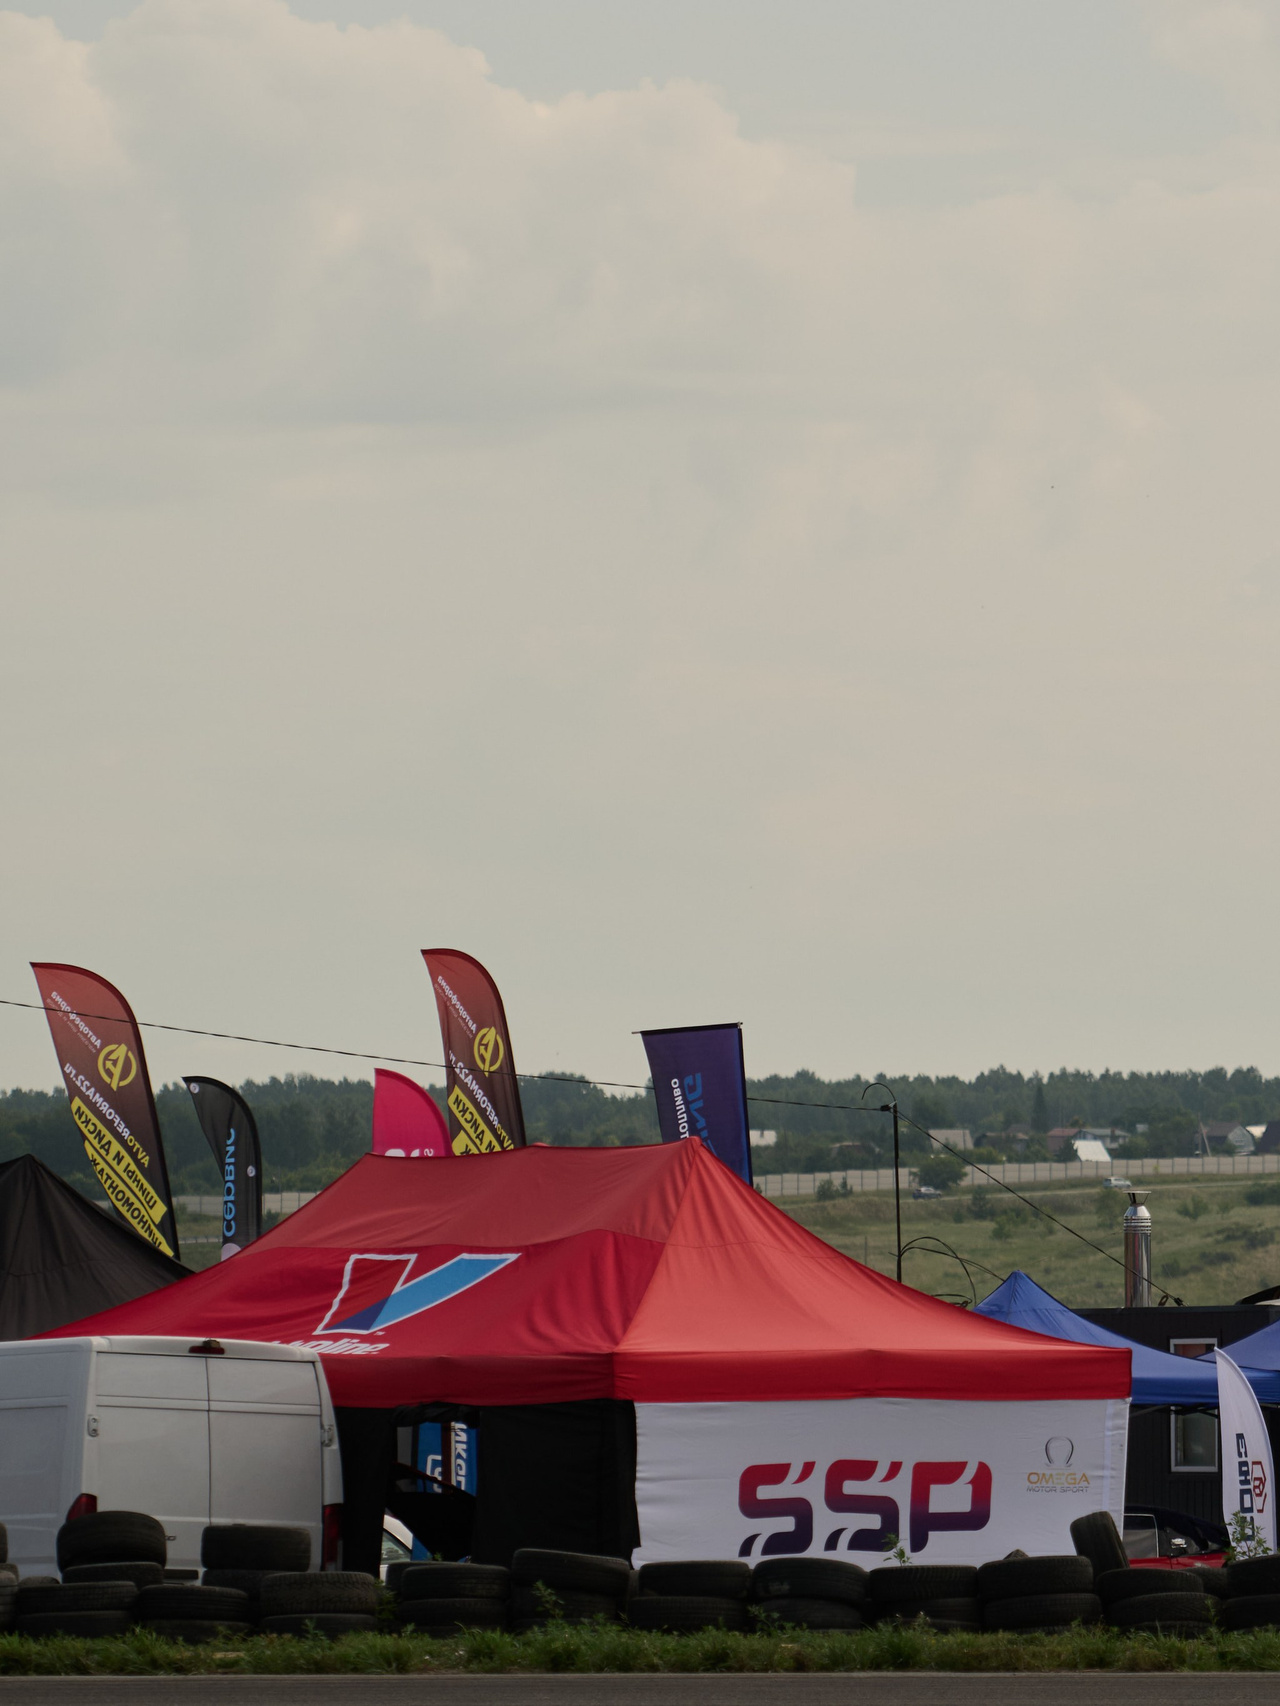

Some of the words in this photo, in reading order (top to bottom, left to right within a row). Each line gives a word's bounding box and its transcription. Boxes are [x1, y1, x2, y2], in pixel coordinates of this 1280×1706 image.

[1027, 1471, 1091, 1486] OMEGA
[1026, 1485, 1057, 1494] MOTOR
[1059, 1485, 1090, 1494] SPORT
[738, 1459, 993, 1558] SSP
